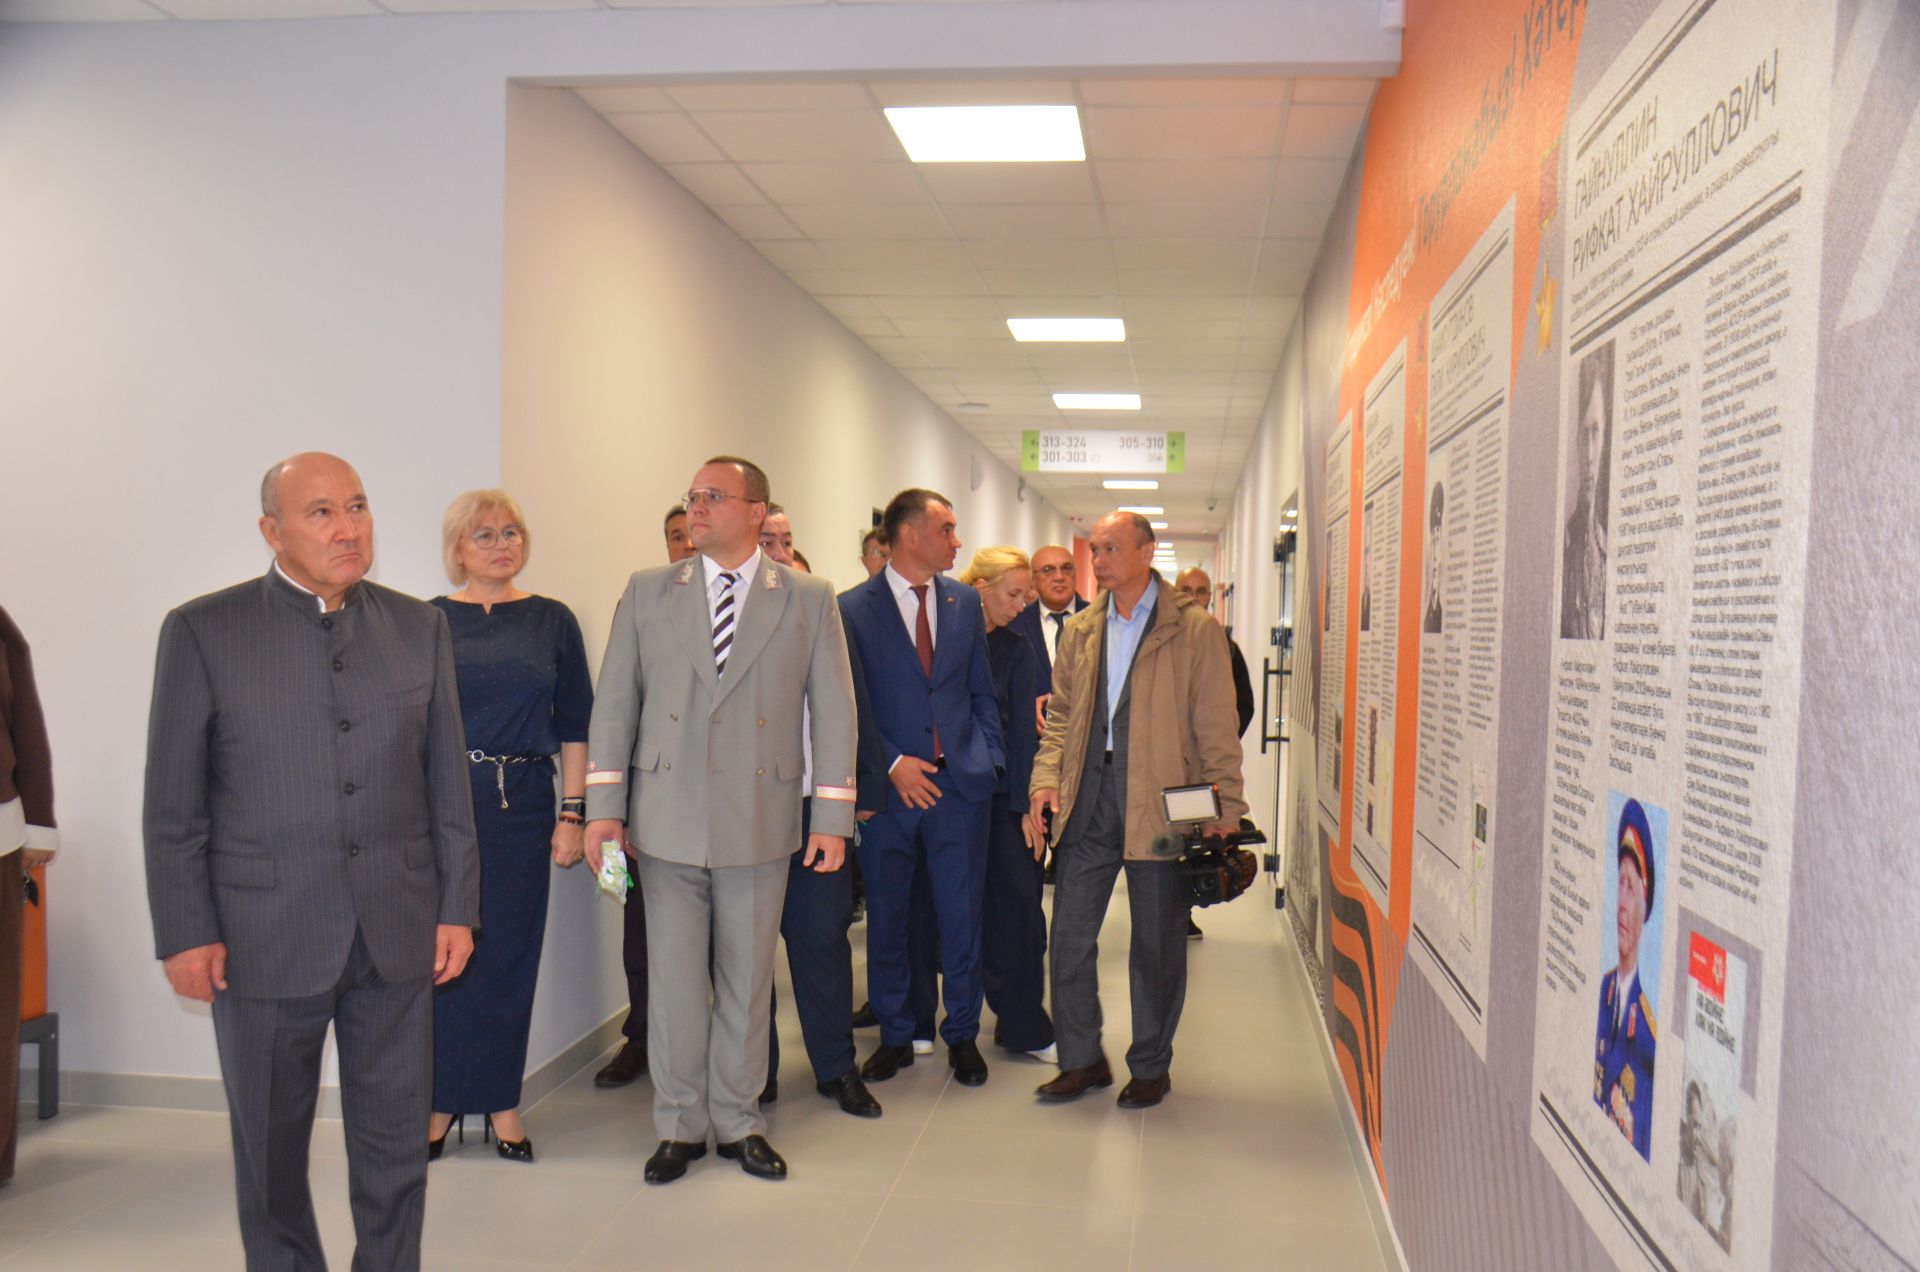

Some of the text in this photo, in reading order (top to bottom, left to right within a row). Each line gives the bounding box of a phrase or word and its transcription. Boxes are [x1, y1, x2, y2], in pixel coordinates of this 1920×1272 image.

[1572, 195, 1625, 278] РИФКАТ
[1626, 48, 1780, 230] ХАЙРУЛЛОВИЧ
[1574, 96, 1659, 220] ГАЙНУЛЛИН
[1042, 435, 1164, 449] 313-324 305-310
[1042, 450, 1087, 463] 301-303
